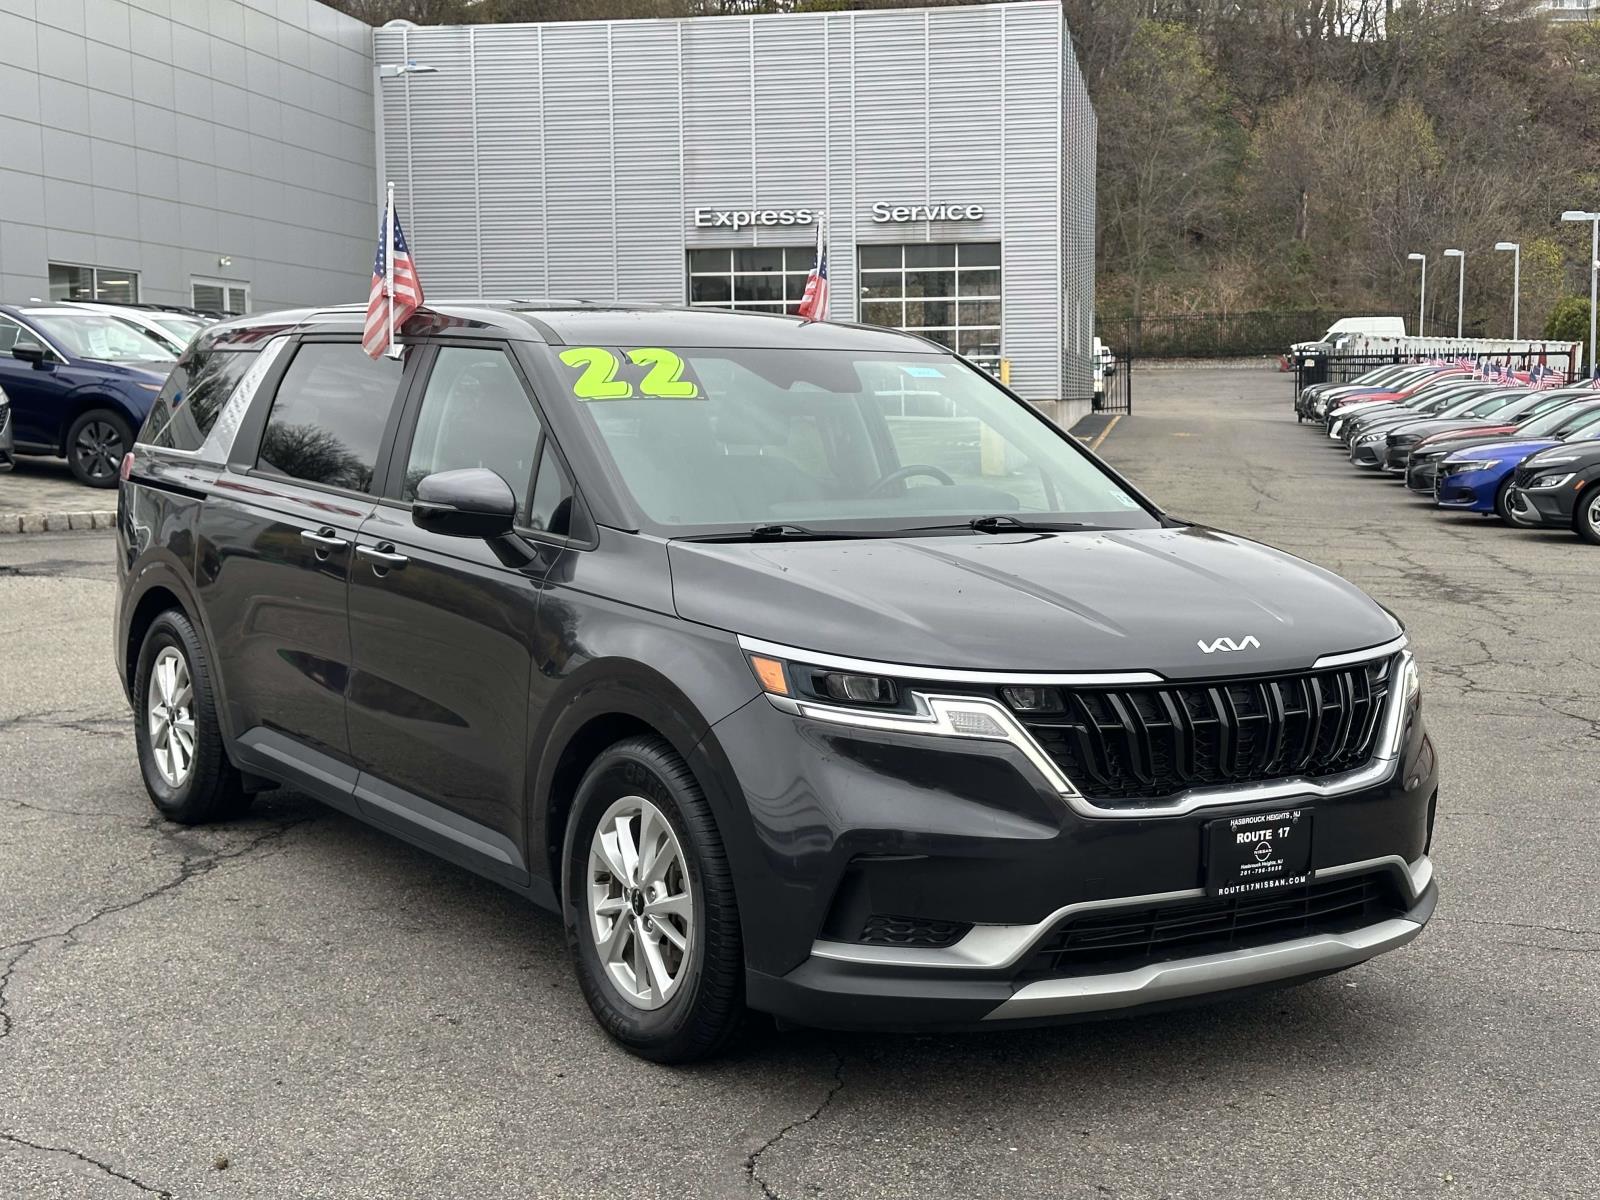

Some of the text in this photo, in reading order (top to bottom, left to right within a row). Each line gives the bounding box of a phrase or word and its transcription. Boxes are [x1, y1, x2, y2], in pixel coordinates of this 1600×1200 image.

[694, 201, 984, 230] Express Service
[558, 347, 699, 399] 22
[1197, 635, 1261, 654] KIA
[1230, 815, 1266, 826] HASBROUCK
[1293, 810, 1301, 818] NJ
[1236, 826, 1290, 844] ROUTE 17
[1218, 875, 1306, 896] ROUTE17NISSAN.COM
